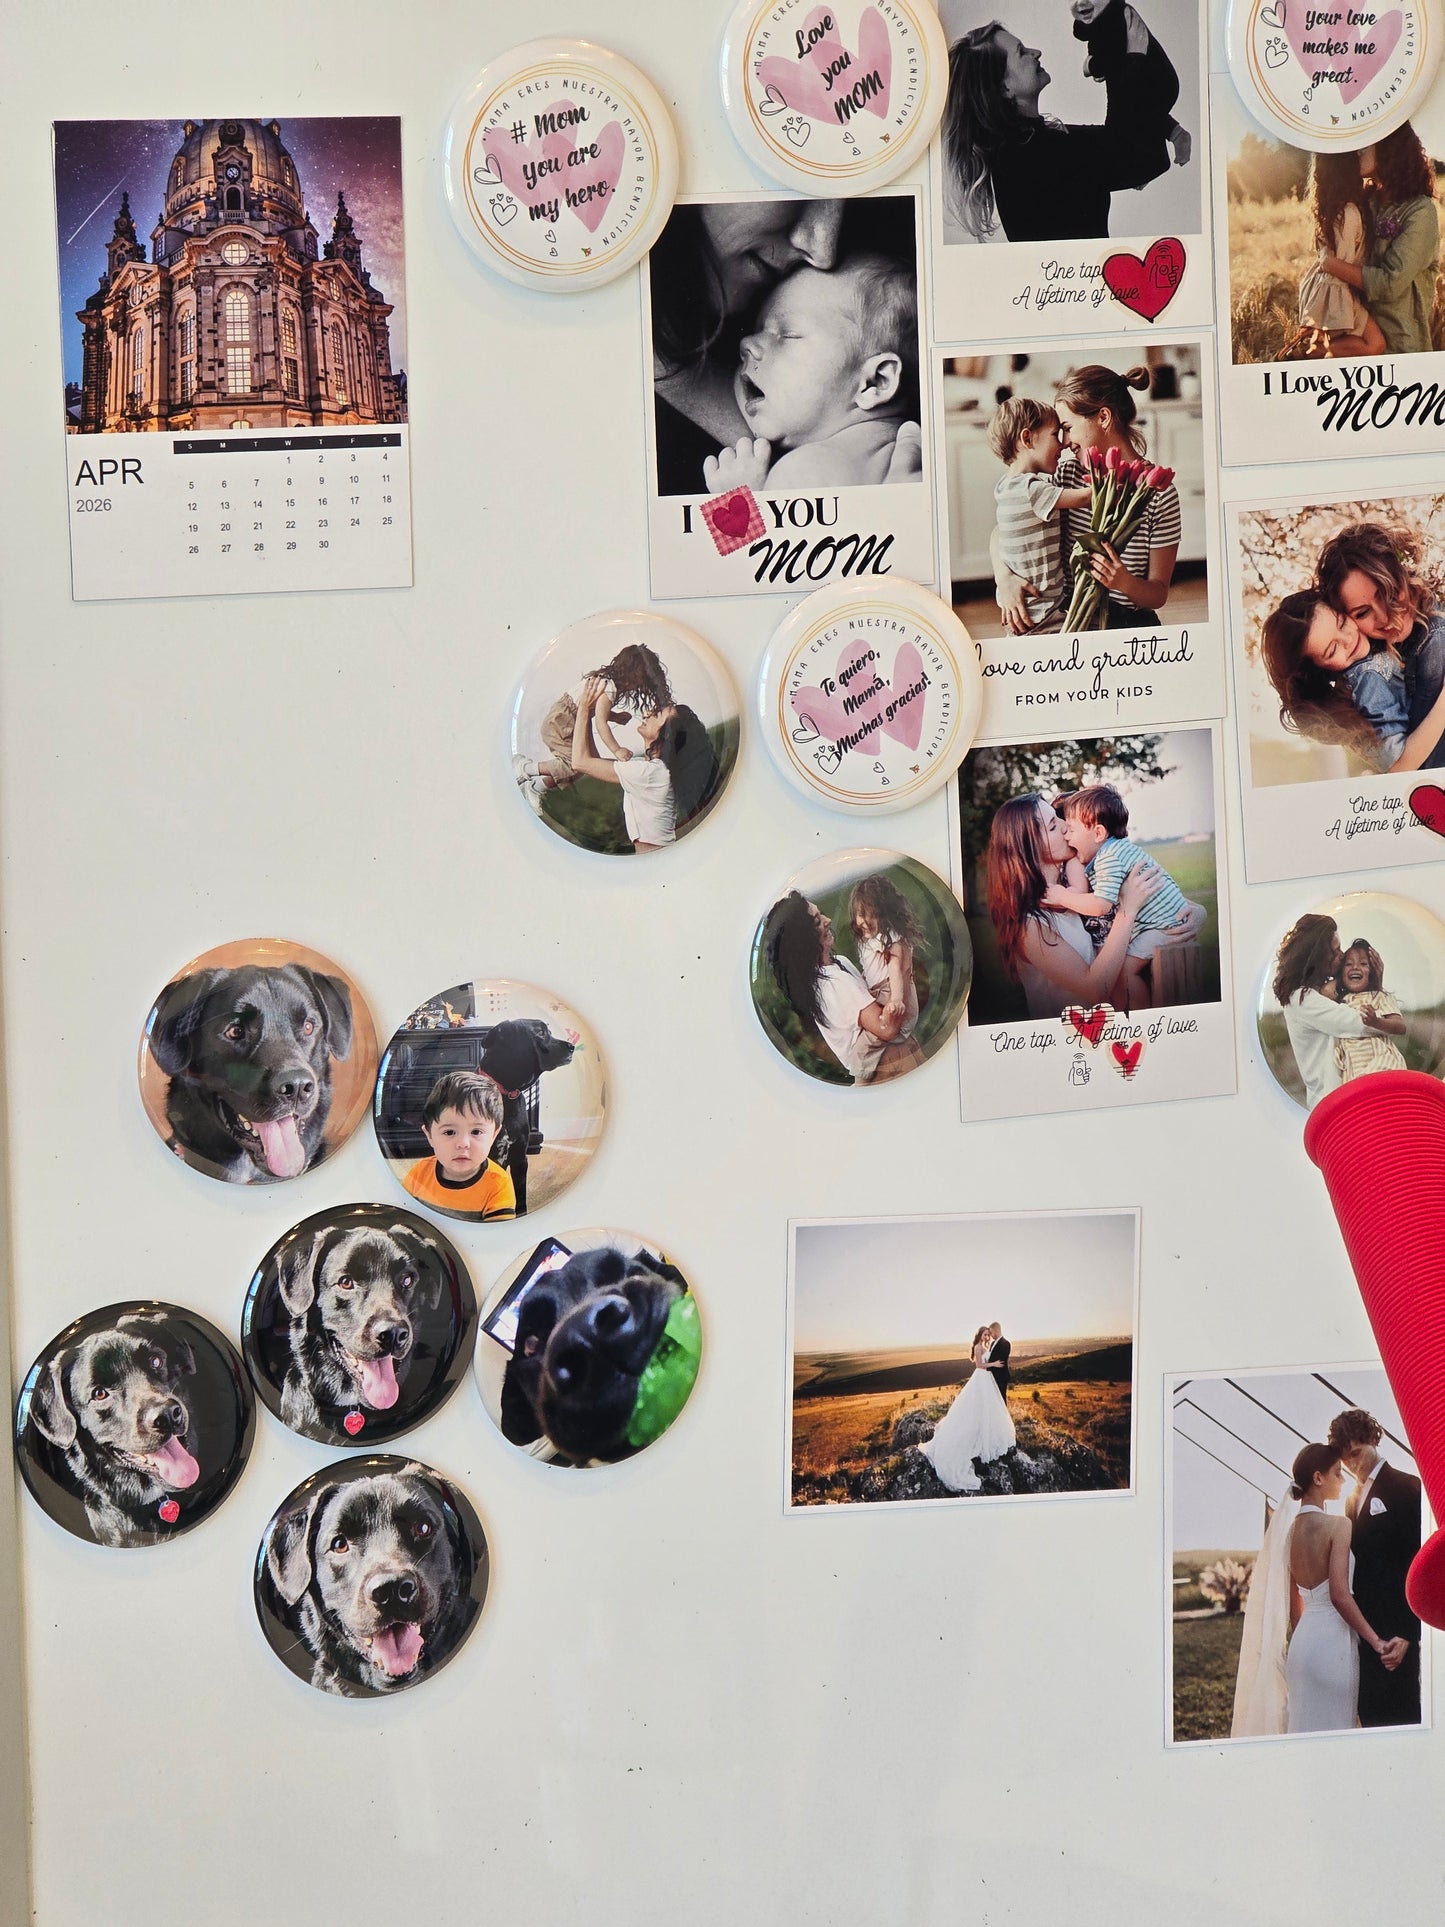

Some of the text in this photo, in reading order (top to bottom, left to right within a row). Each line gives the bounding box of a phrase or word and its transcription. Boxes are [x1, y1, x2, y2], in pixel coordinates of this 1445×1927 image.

[1347, 9, 1377, 25] love
[754, 31, 772, 67] MAMA
[795, 15, 834, 59] Love
[1302, 38, 1377, 56] makes me
[821, 51, 851, 91] you
[877, 0, 918, 125] MAYOR BENDICION
[1312, 67, 1358, 88] great.
[1351, 12, 1415, 121] MAYOR BENDICION
[511, 106, 591, 144] # Mom
[482, 79, 645, 246] MAMA ERES NUESTRA MAYOR BENDICION
[522, 143, 602, 190] you are
[528, 180, 616, 223] my hero.
[1041, 260, 1075, 281] One
[1013, 286, 1031, 309] A
[1035, 284, 1086, 310] lifetime
[1091, 282, 1106, 308] of
[1263, 364, 1395, 395] I Love YOU
[75, 458, 144, 486] APR
[286, 453, 388, 464] 1 2 3 4
[188, 474, 391, 490] 5 6 7 8 9 10 11
[76, 498, 112, 513] 2026
[187, 495, 392, 511] 12 13 14 15 16 17 18
[682, 496, 839, 533] I YOU
[188, 517, 393, 533] 19 20 21 22 23 24 25
[188, 540, 329, 554] 26 27 28 29 30
[820, 649, 881, 698] Te quiero,
[1032, 638, 1084, 673] and
[1091, 630, 1193, 691] gratitud
[790, 618, 950, 758] MAMA ERES NUESTRA MAYOR BENDICION
[843, 674, 891, 716] Mamá,
[885, 671, 932, 722] gracias!
[1016, 685, 1153, 706] FROM YOUR KIDS
[1349, 795, 1404, 813] One tap.
[1325, 819, 1341, 840] A
[1345, 816, 1389, 840] lifetime
[1393, 811, 1408, 834] of
[990, 1015, 1199, 1053] One tap. A lifetime of love.
